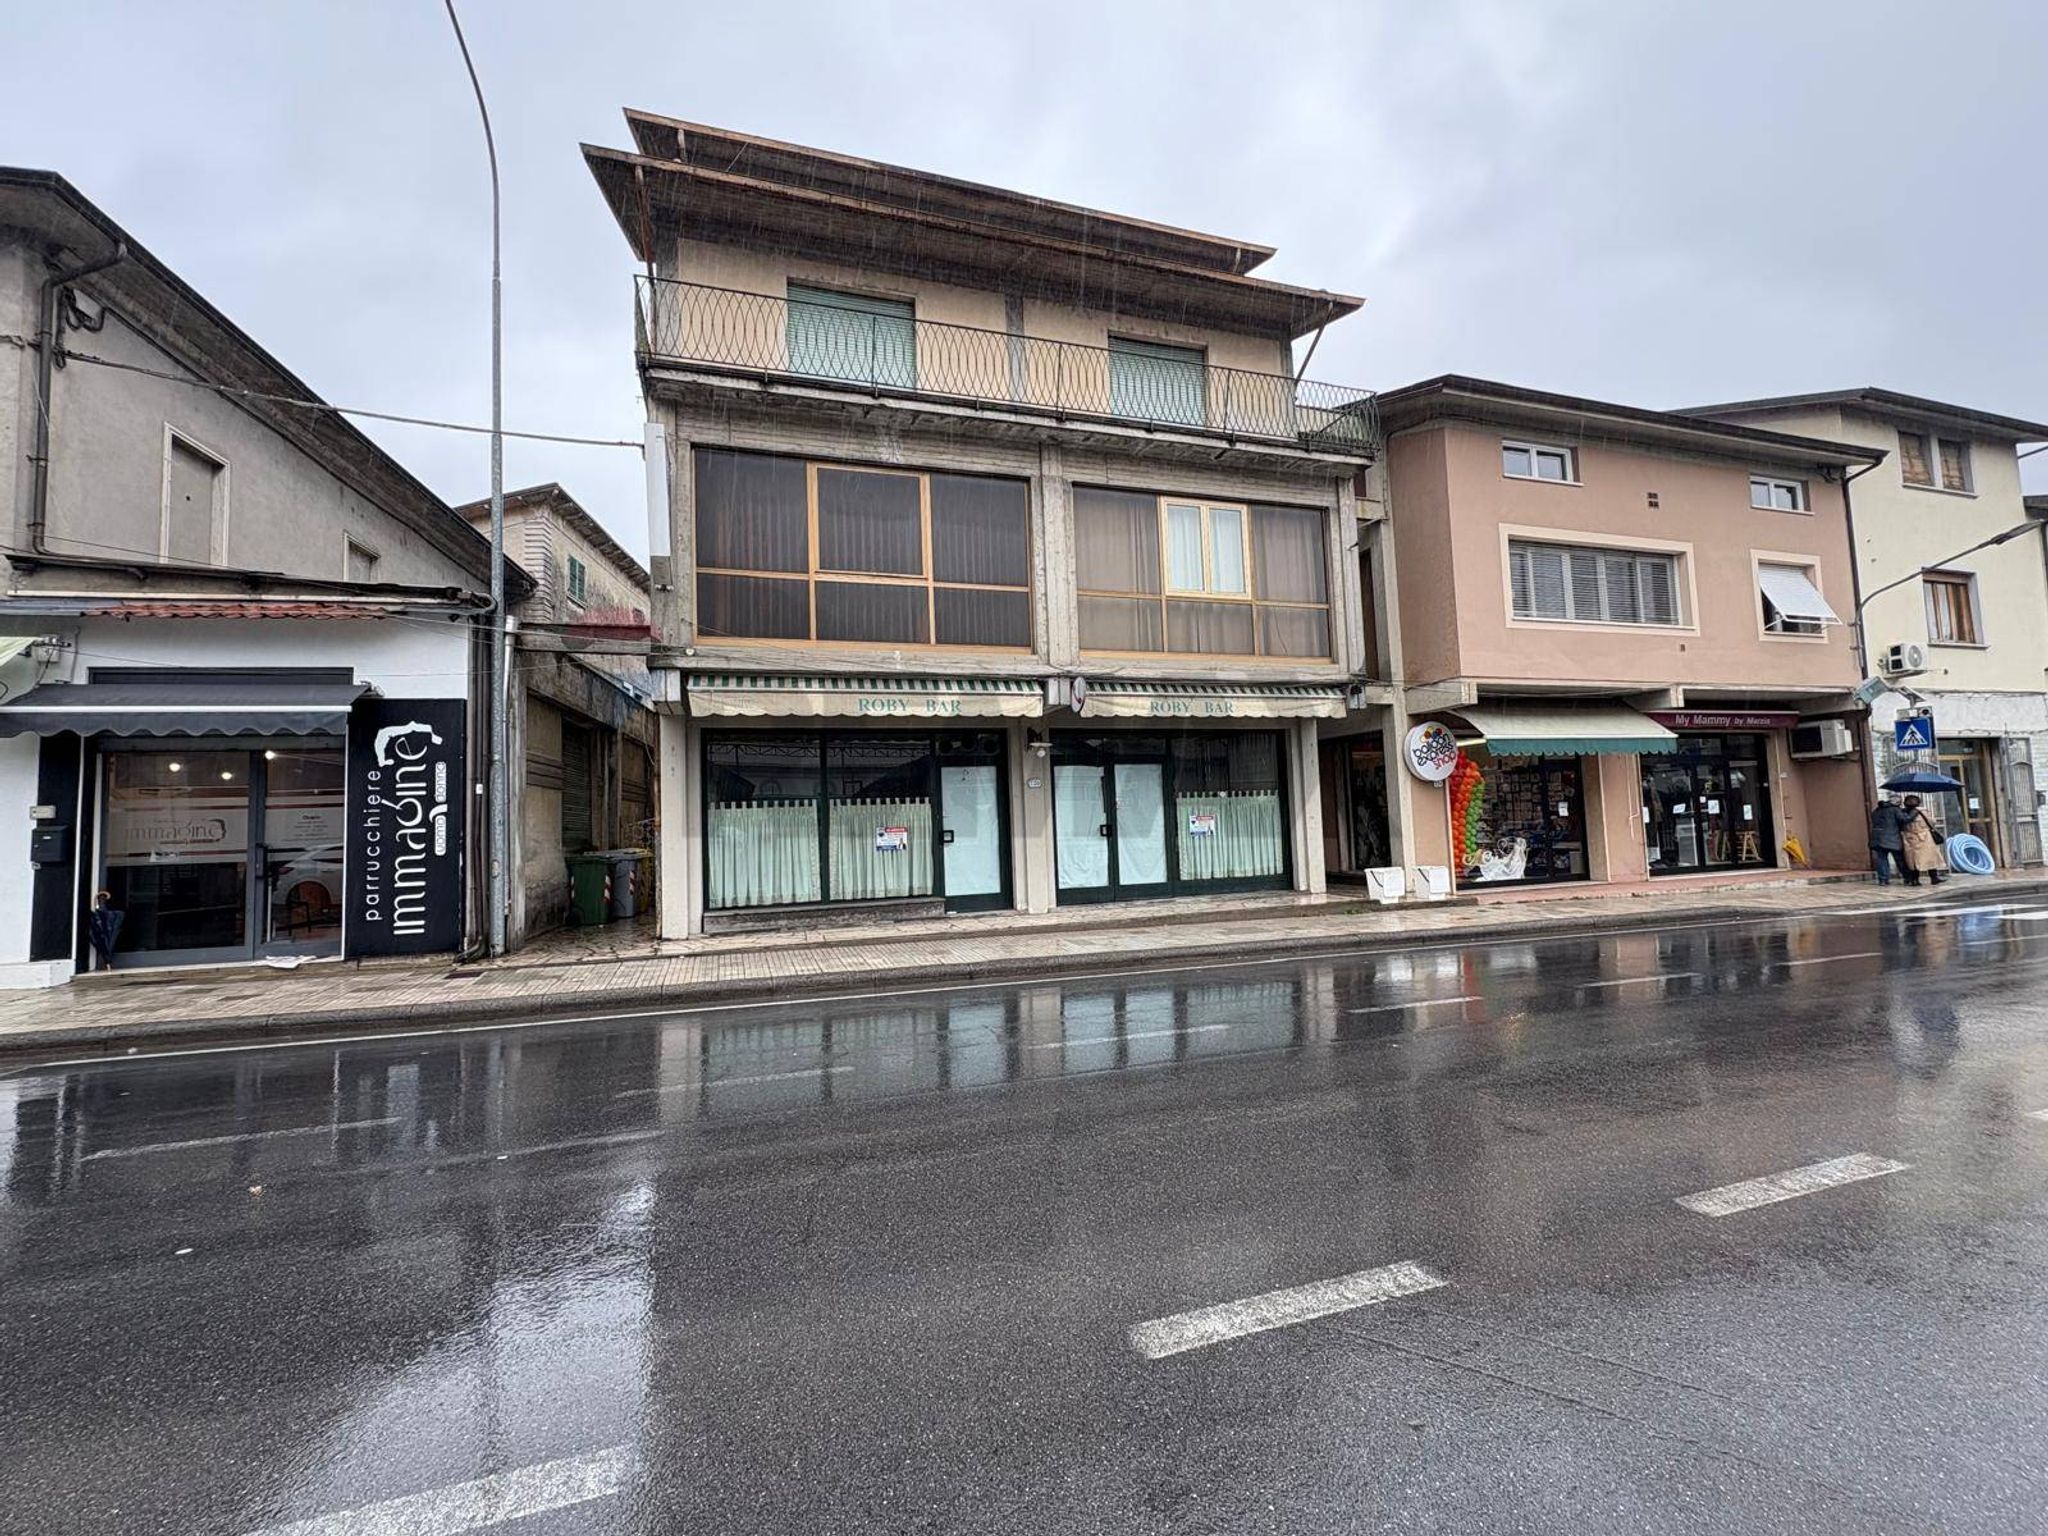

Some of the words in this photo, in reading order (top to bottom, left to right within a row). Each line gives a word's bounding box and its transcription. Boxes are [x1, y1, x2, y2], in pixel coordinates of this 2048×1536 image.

[859, 698, 909, 712] ROBY
[926, 698, 961, 713] BAR
[1150, 701, 1191, 713] ROBY
[1204, 701, 1234, 713] BAR
[1675, 714, 1690, 727] My
[1693, 714, 1731, 727] Mammy
[363, 770, 383, 921] parrucchiere
